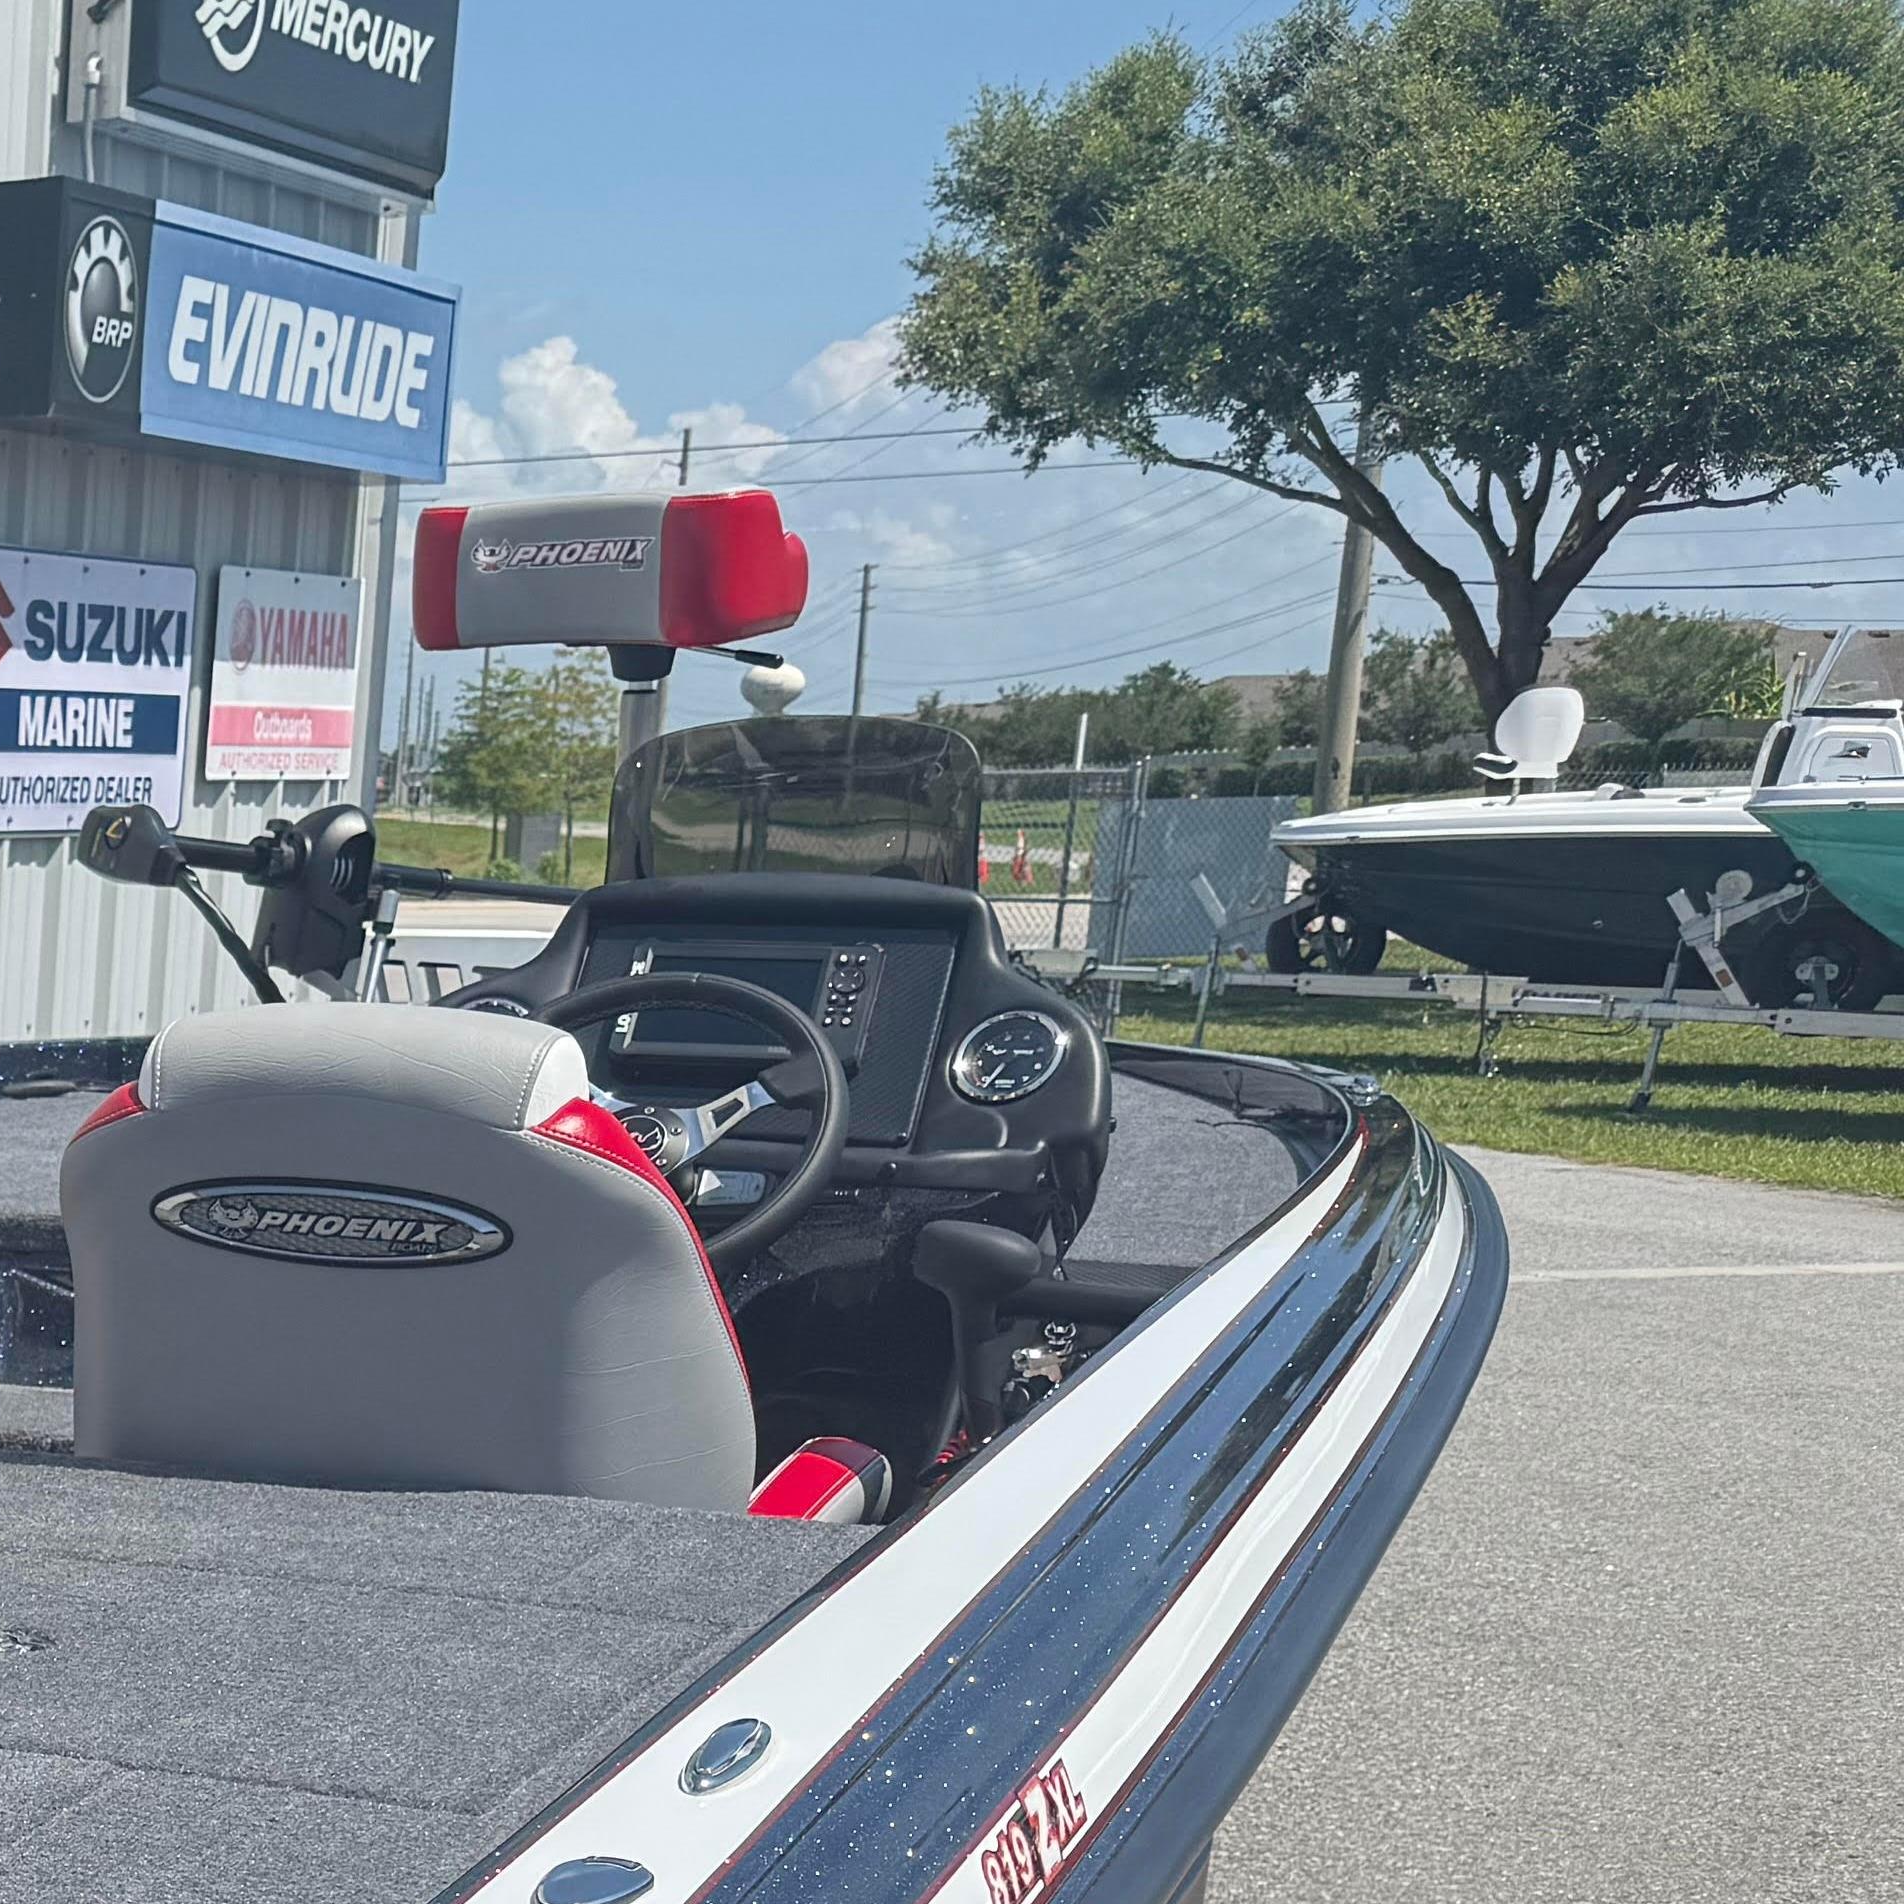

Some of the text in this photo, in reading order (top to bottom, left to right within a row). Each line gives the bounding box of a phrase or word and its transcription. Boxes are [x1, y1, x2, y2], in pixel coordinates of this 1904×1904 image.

[270, 0, 436, 83] MERCURY
[92, 316, 133, 349] BRP
[168, 275, 435, 429] EVINRUDE
[509, 538, 655, 567] PHOENIX
[24, 599, 187, 668] SUZUKI
[259, 607, 349, 671] YAMAHA
[18, 695, 135, 749] MARINE
[253, 711, 313, 742] Outboards
[219, 752, 340, 771] AUTHORIZED SERVICE
[95, 776, 152, 806] DEALER
[257, 1210, 447, 1243] PHOENIX
